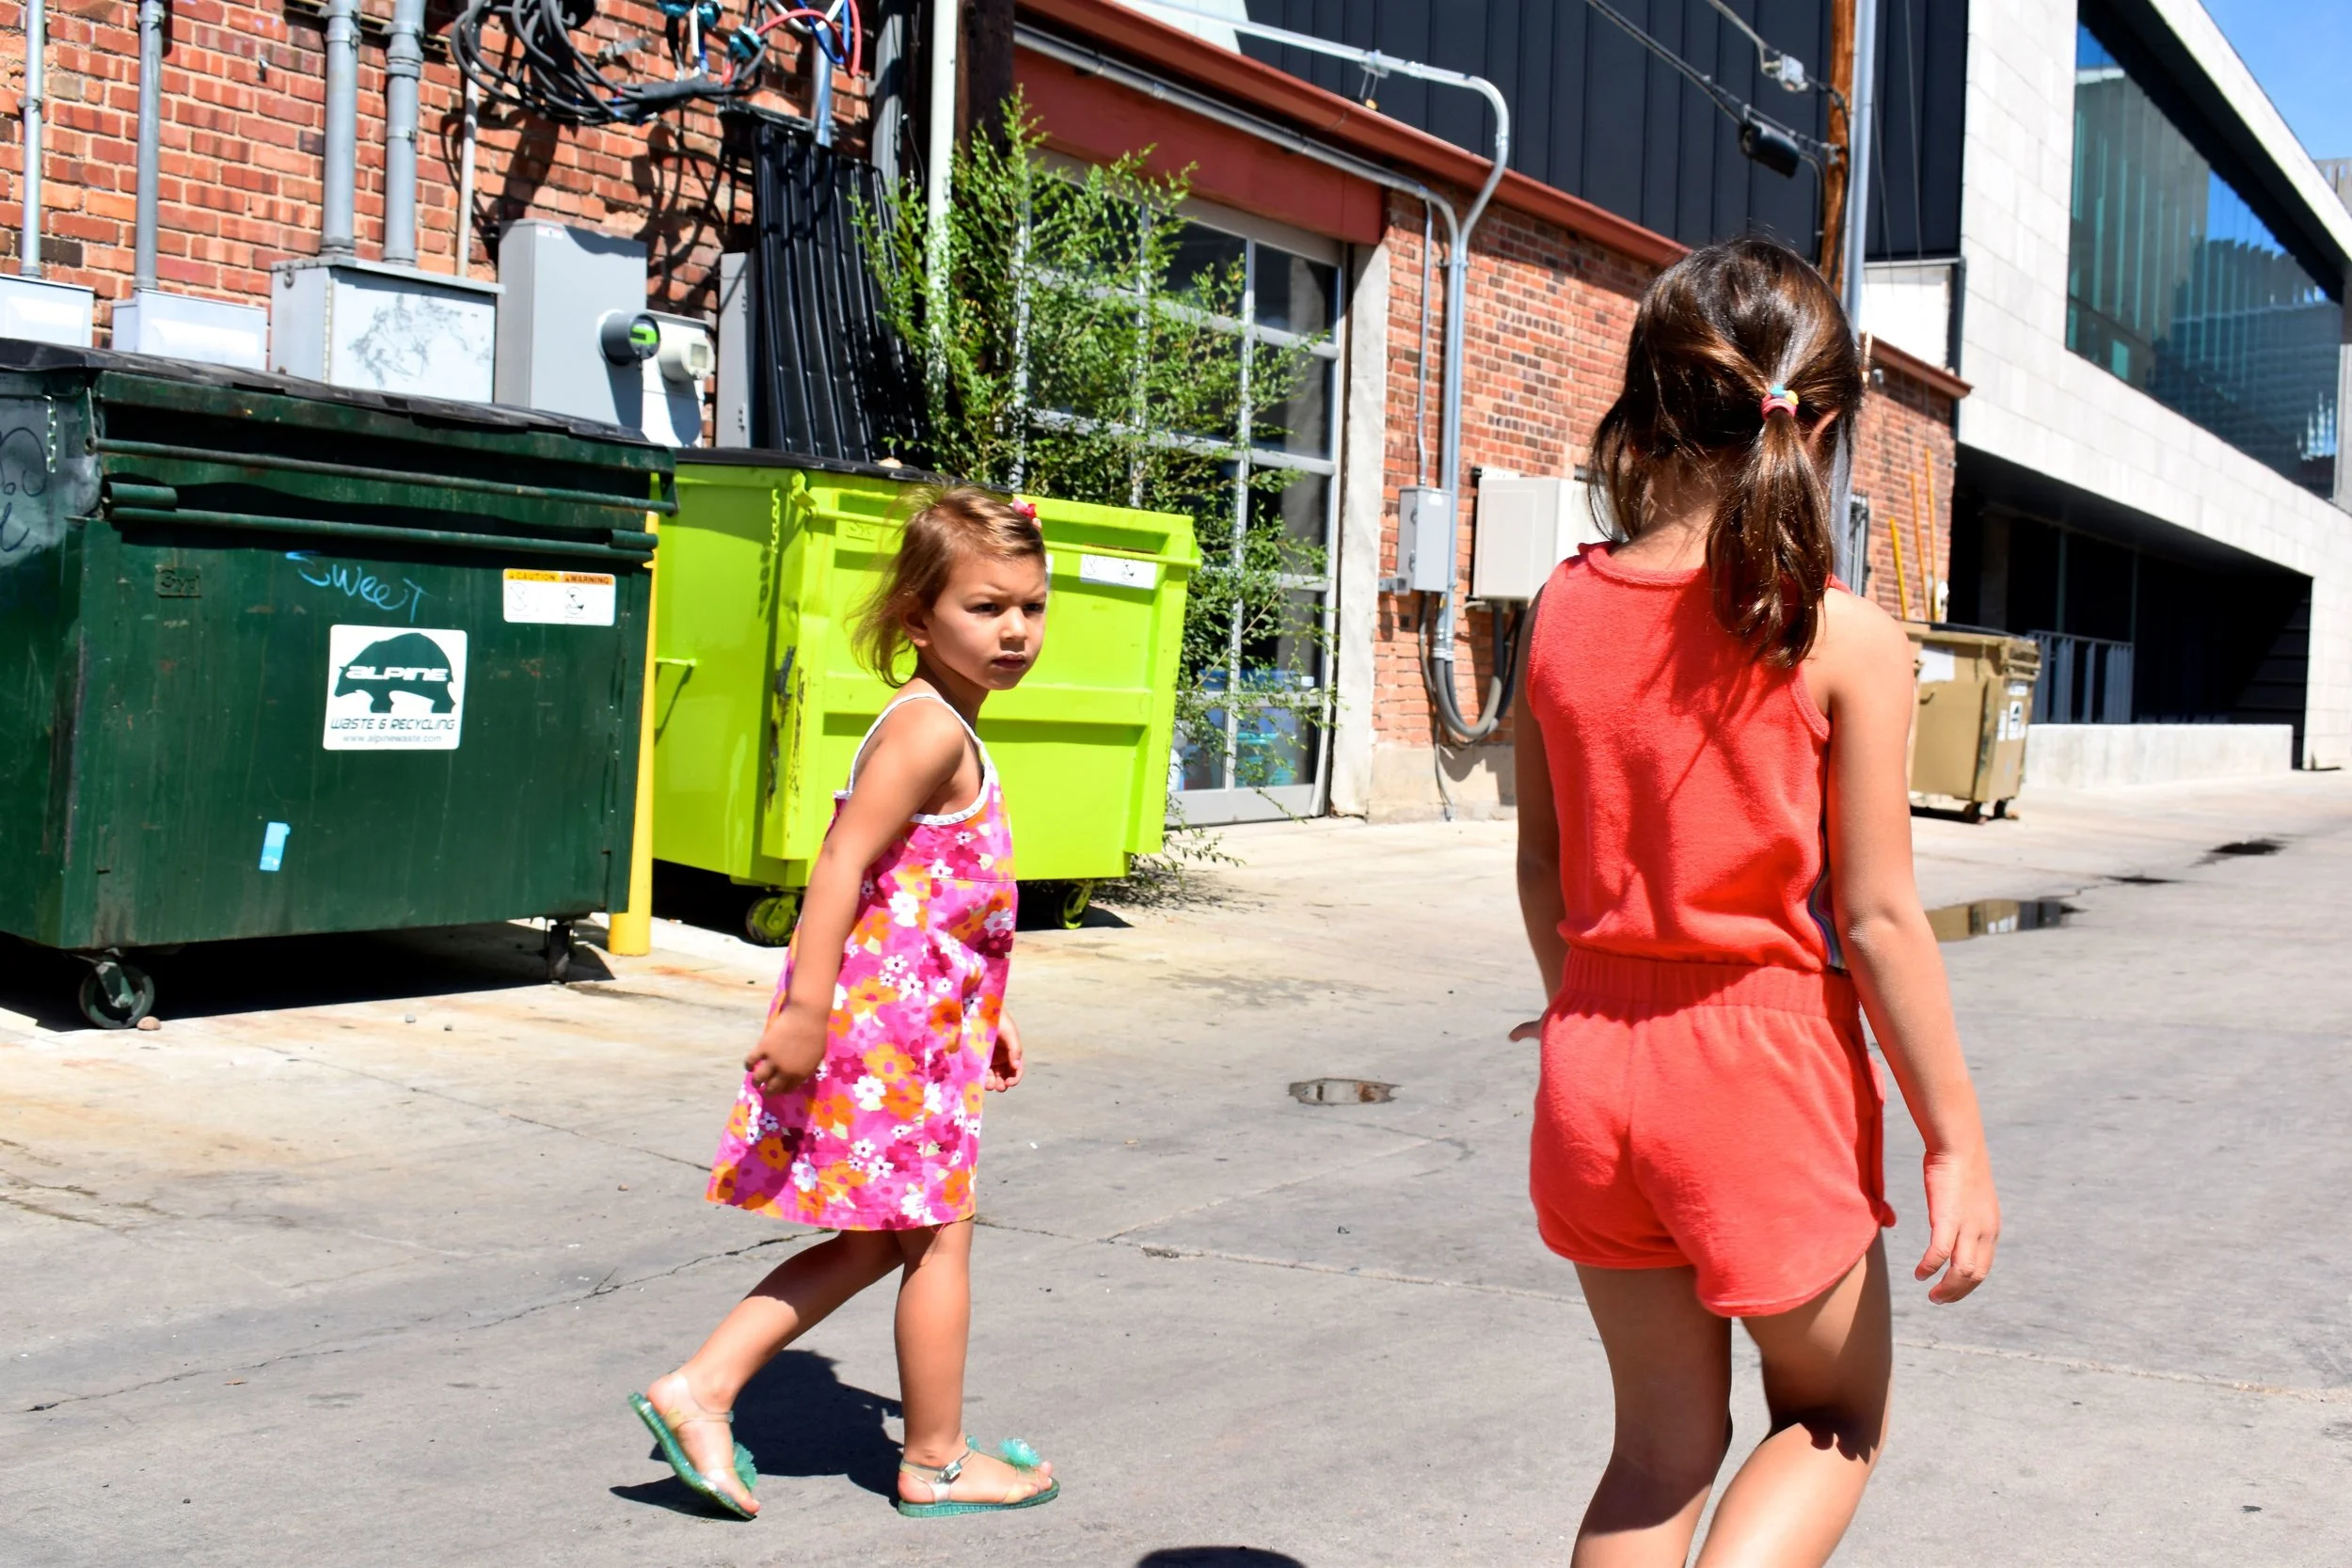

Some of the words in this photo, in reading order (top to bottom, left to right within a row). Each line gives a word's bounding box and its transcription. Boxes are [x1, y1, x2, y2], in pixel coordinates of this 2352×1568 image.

[516, 571, 556, 581] CAUTION
[571, 575, 610, 585] WARNING
[378, 718, 388, 730] &
[389, 718, 455, 730] RECYCLING
